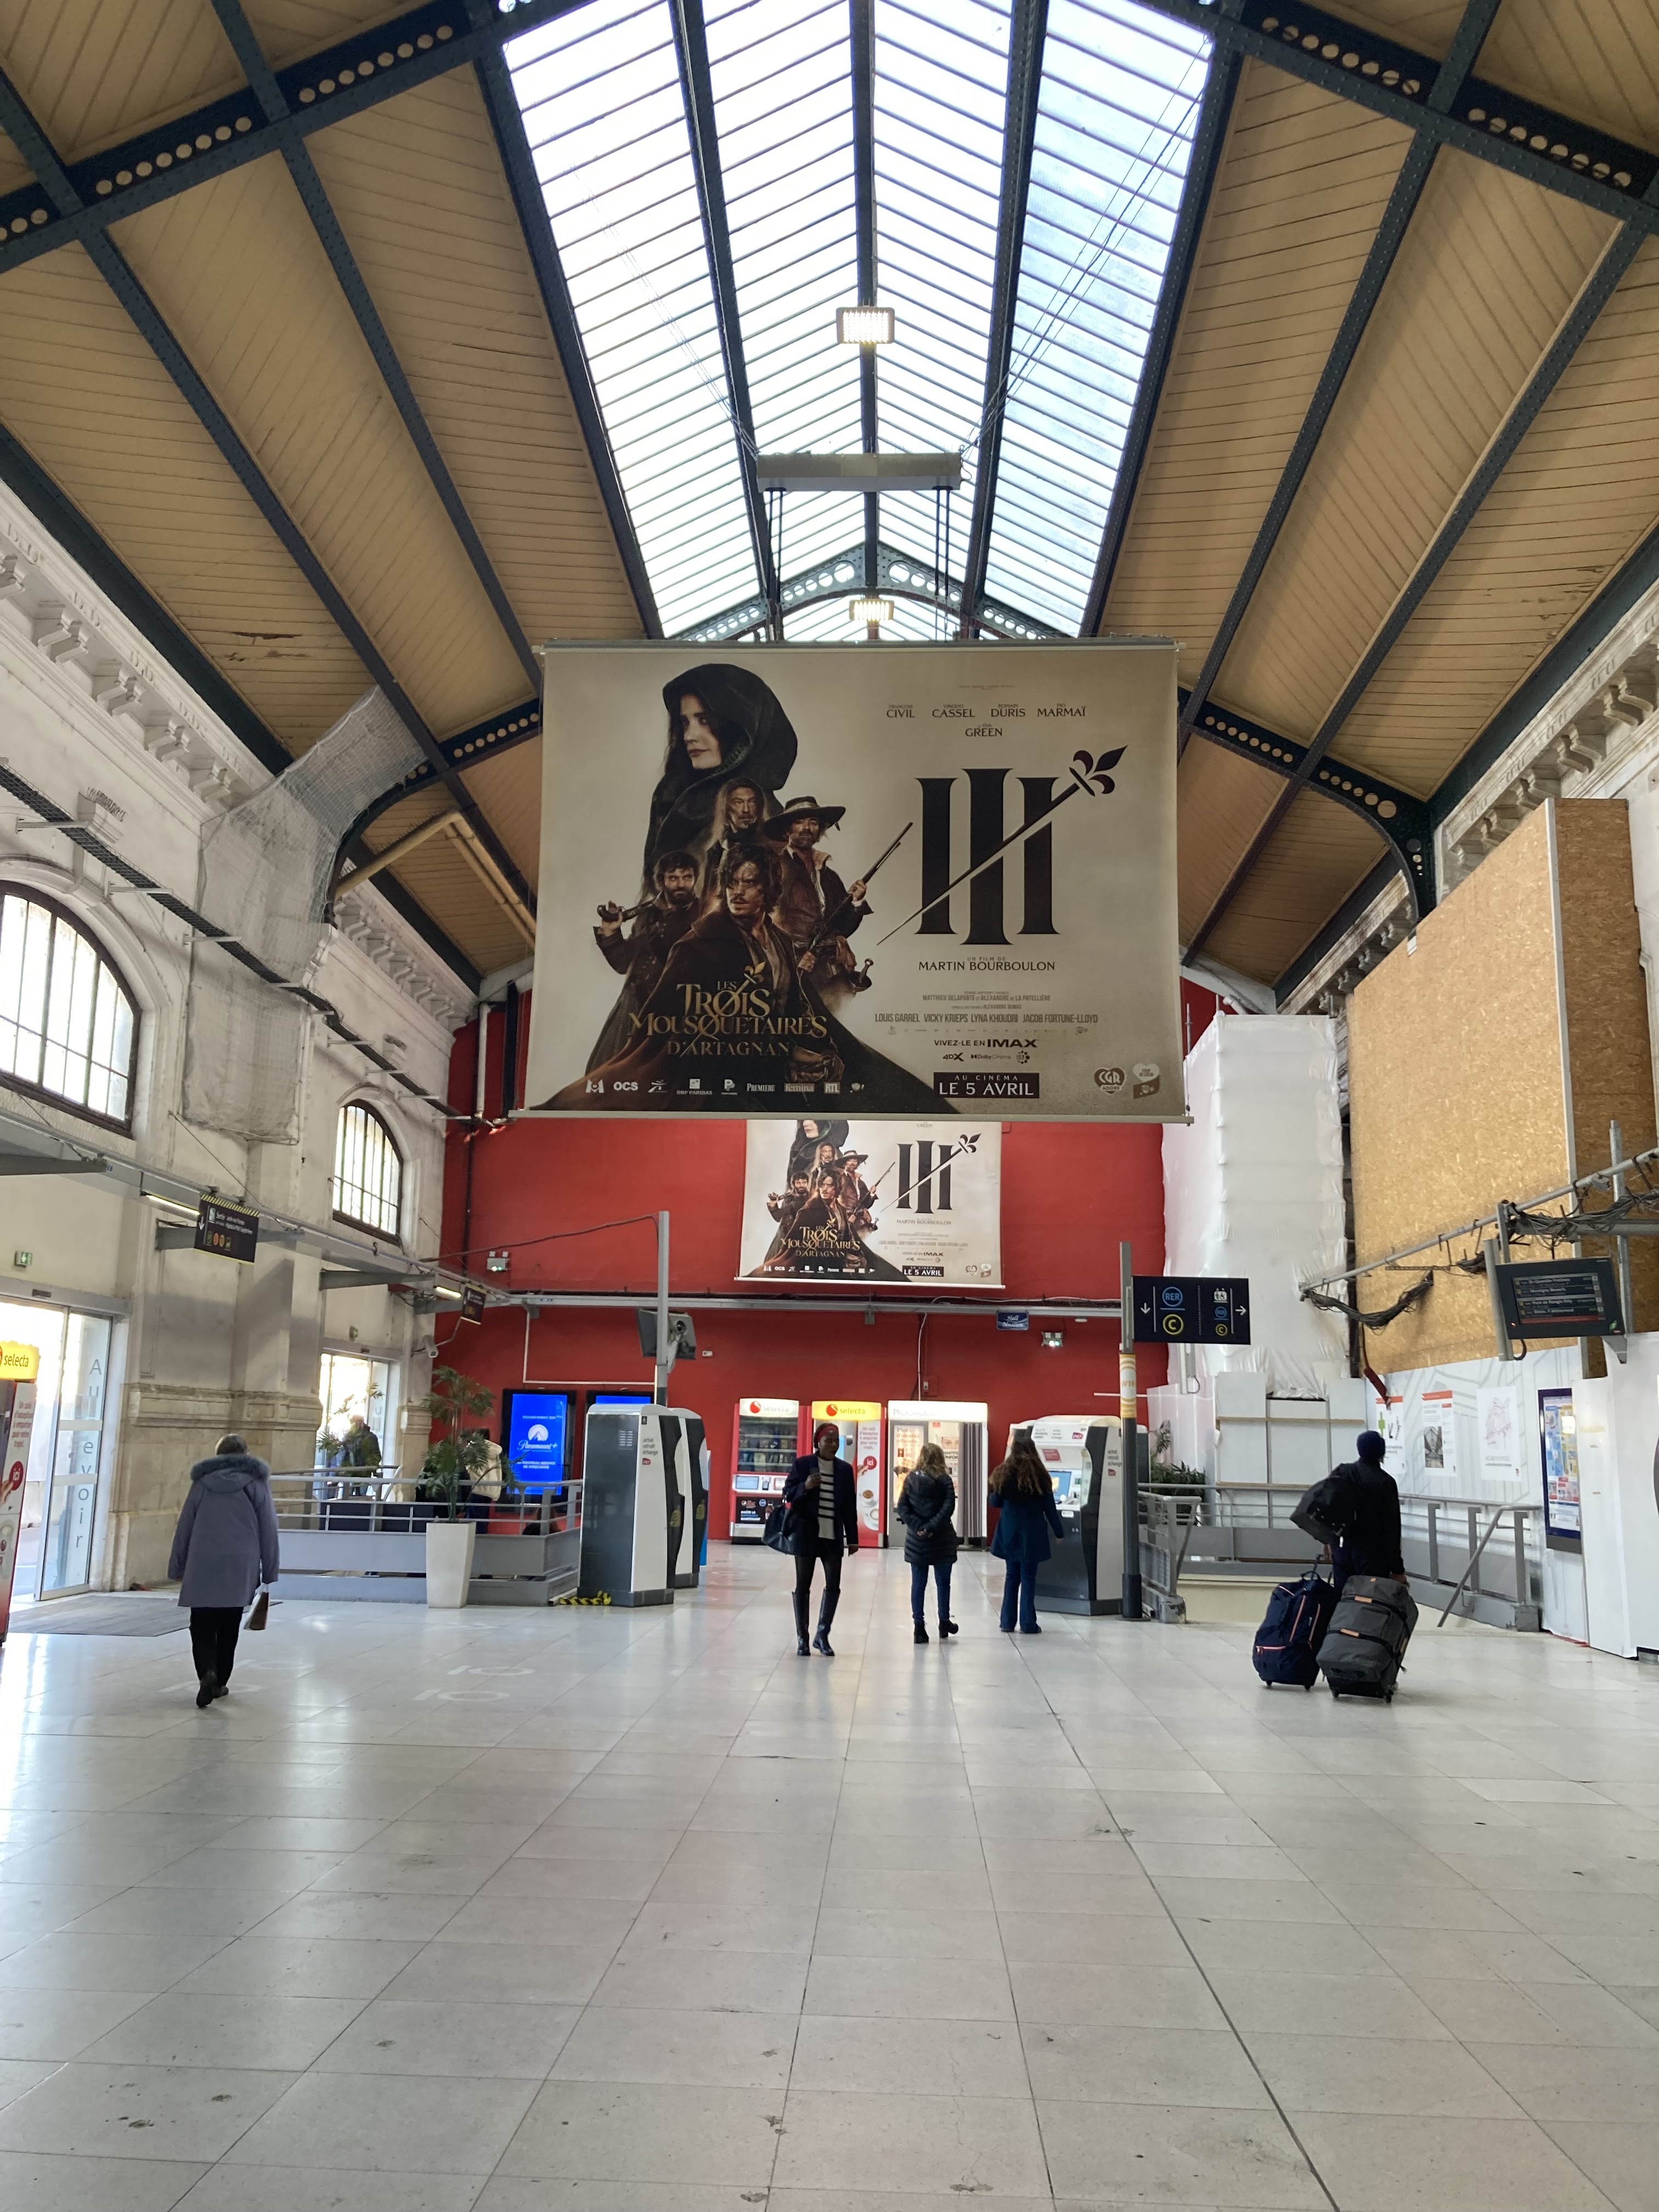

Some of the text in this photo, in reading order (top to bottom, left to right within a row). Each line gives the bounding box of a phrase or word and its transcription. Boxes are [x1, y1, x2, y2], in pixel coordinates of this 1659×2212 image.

[887, 709, 915, 718] CIVIL
[932, 709, 975, 718] CASSEL
[991, 708, 1025, 717] DURIS
[1037, 706, 1086, 716] MARMAÏ
[965, 728, 1002, 737] GREEN
[918, 961, 1055, 970] MARTIN BOURBOULON
[717, 981, 737, 990] LES
[676, 983, 771, 1017] TROIS
[875, 1013, 1098, 1023] LOUIS GARREL VICKY KRIEPS LYNA KHOUDRI JACOB FORTUNE-LLOYD
[627, 1013, 827, 1040] MOUSQUETAIRES
[988, 1039, 1038, 1047] IMAX
[668, 1041, 790, 1057] D'ARTAGNAN
[943, 1052, 964, 1062] 4DX
[613, 1081, 639, 1091] OCS
[825, 1084, 839, 1093] RTL
[939, 1082, 1034, 1095] LE 5 AVRIL
[799, 1226, 838, 1242] TROIS
[781, 1238, 860, 1250] MOUSQUETAIRES
[1165, 1293, 1180, 1301] RER
[1168, 1319, 1177, 1330] C
[4, 1353, 29, 1367] selecta
[517, 1440, 558, 1451] Paramount+
